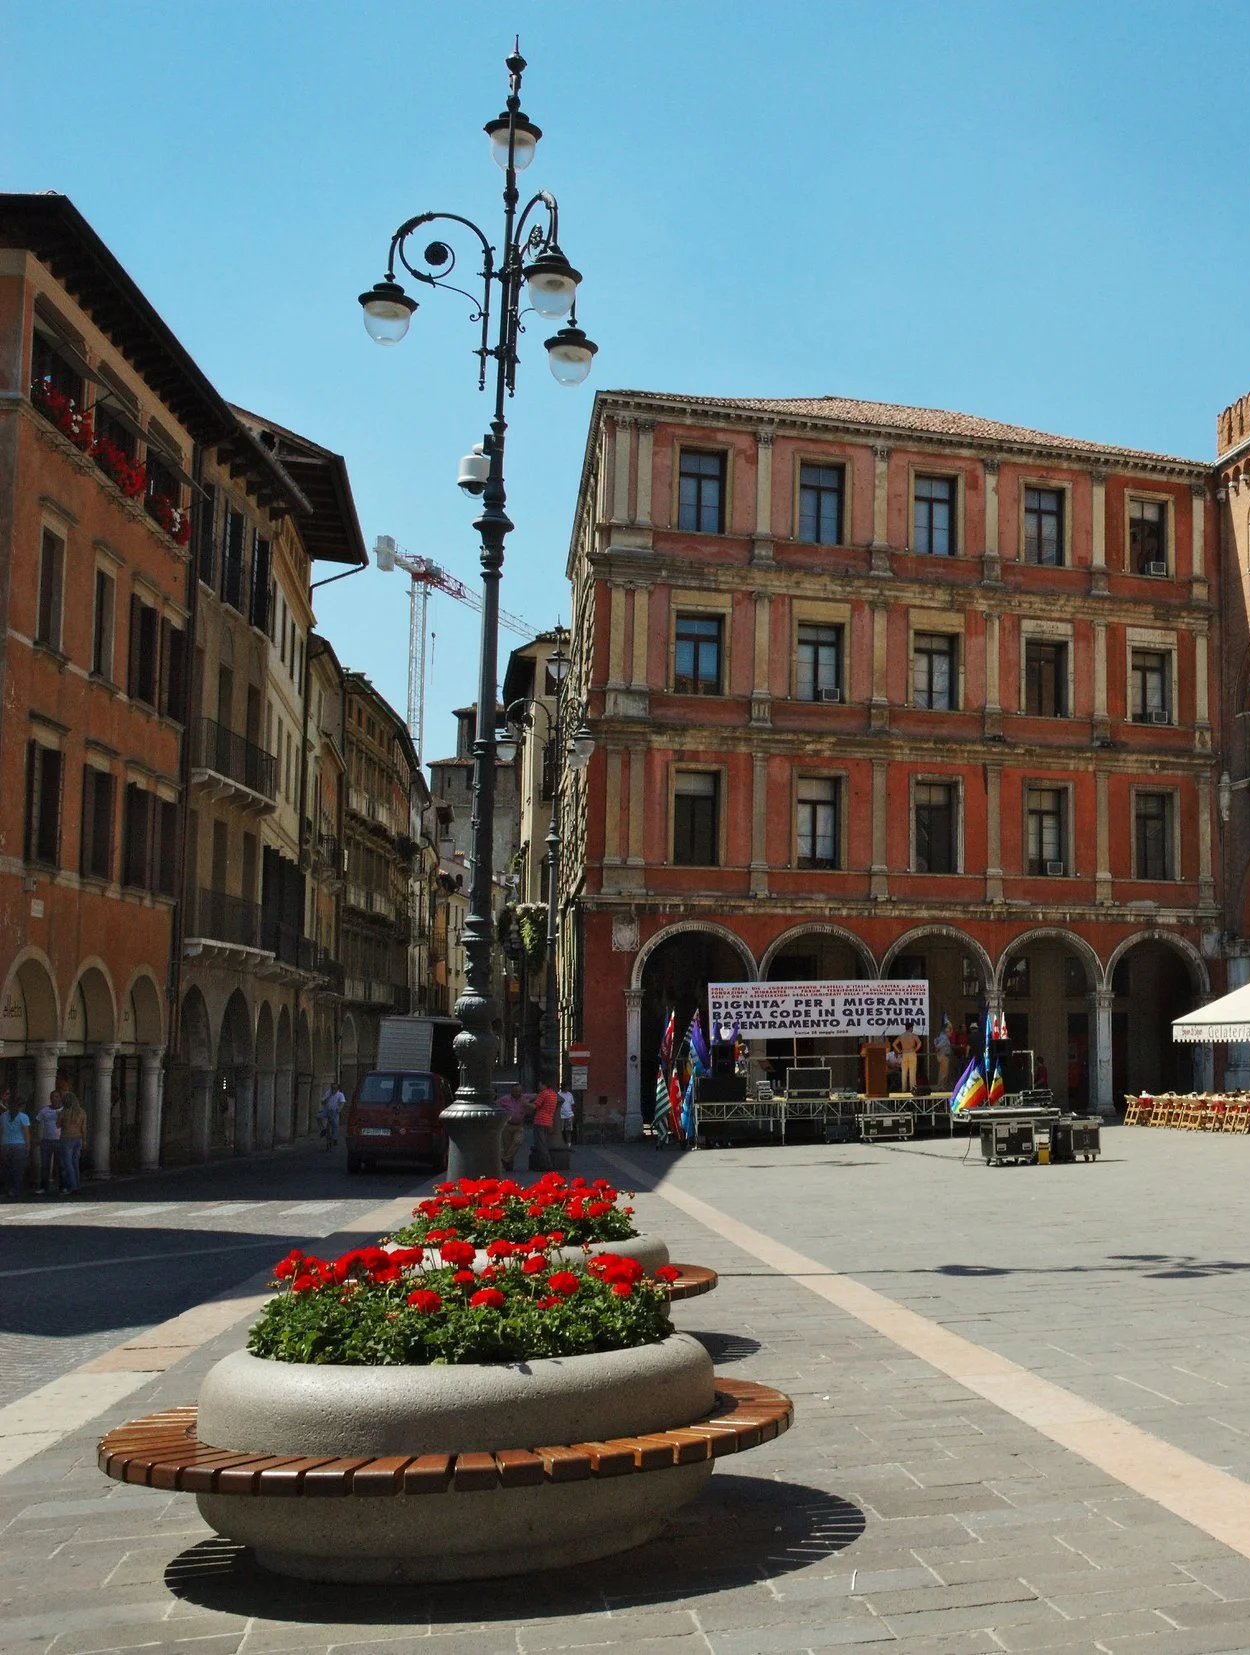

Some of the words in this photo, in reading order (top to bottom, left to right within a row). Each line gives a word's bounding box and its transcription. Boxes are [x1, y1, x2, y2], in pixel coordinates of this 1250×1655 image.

[712, 1000, 785, 1010] DIGNITA'
[794, 998, 823, 1008] PER
[831, 998, 836, 1007] I
[843, 997, 924, 1007] MIGRANTI
[712, 1010, 763, 1020] BASTA
[769, 1009, 812, 1019] CODE
[818, 1008, 835, 1017] IN
[842, 1007, 925, 1017] QUESTURA
[846, 1018, 861, 1027] AI
[867, 1017, 926, 1026] COMUNI
[1208, 1025, 1250, 1039] Gelateria
